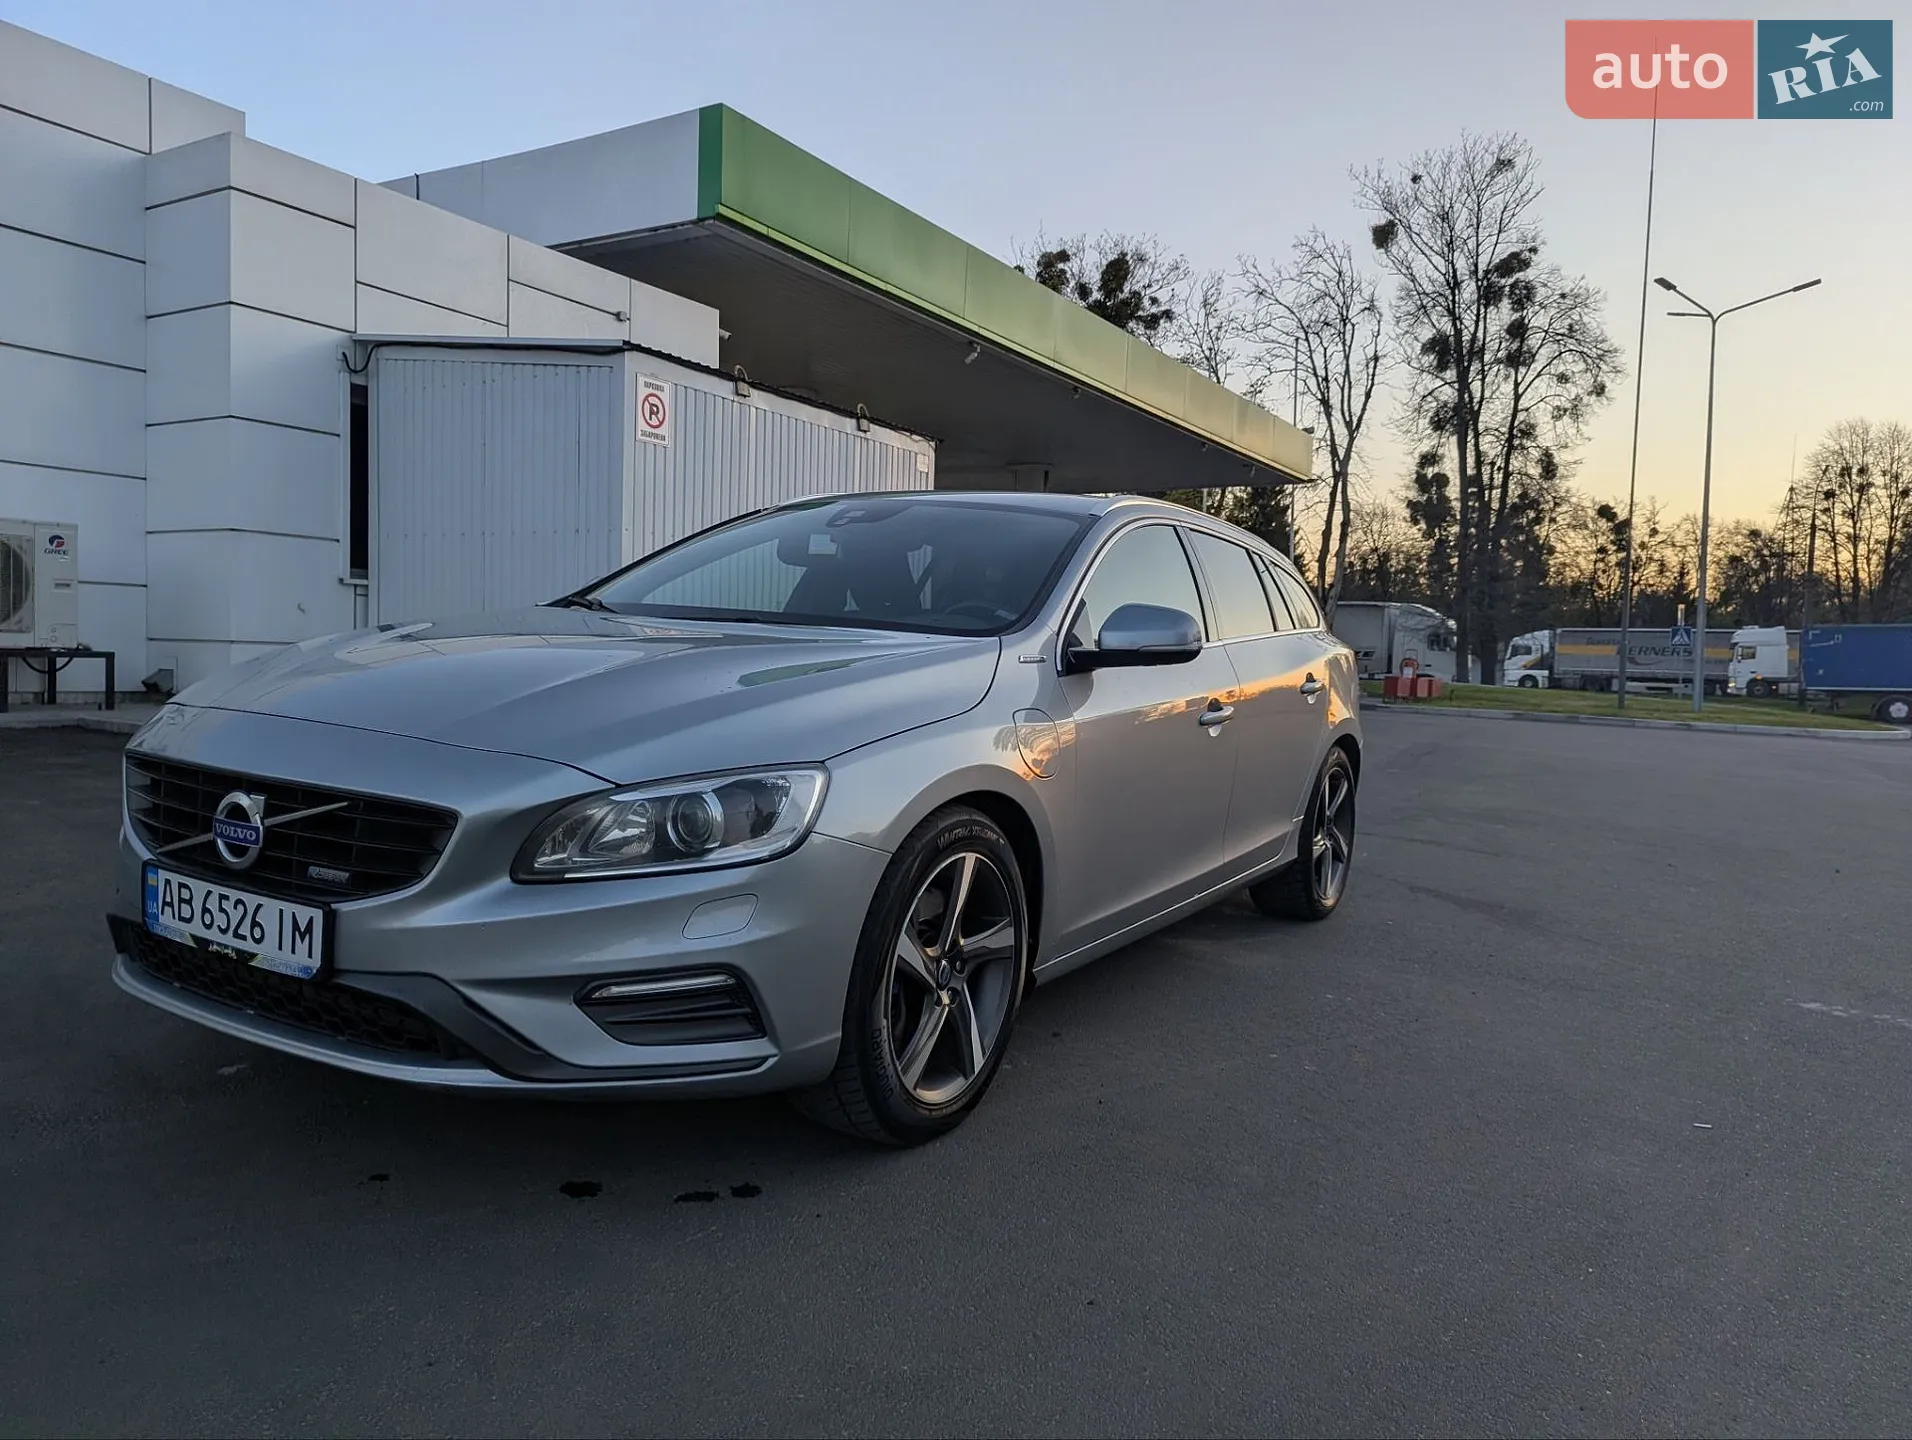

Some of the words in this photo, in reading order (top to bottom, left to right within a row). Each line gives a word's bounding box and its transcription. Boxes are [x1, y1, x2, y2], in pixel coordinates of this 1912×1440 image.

[1616, 645, 1694, 658] ERNERS
[215, 823, 257, 841] VOLVO
[147, 902, 158, 916] UA
[160, 877, 195, 924] AB
[201, 889, 265, 945] 6526
[277, 908, 314, 959] IM
